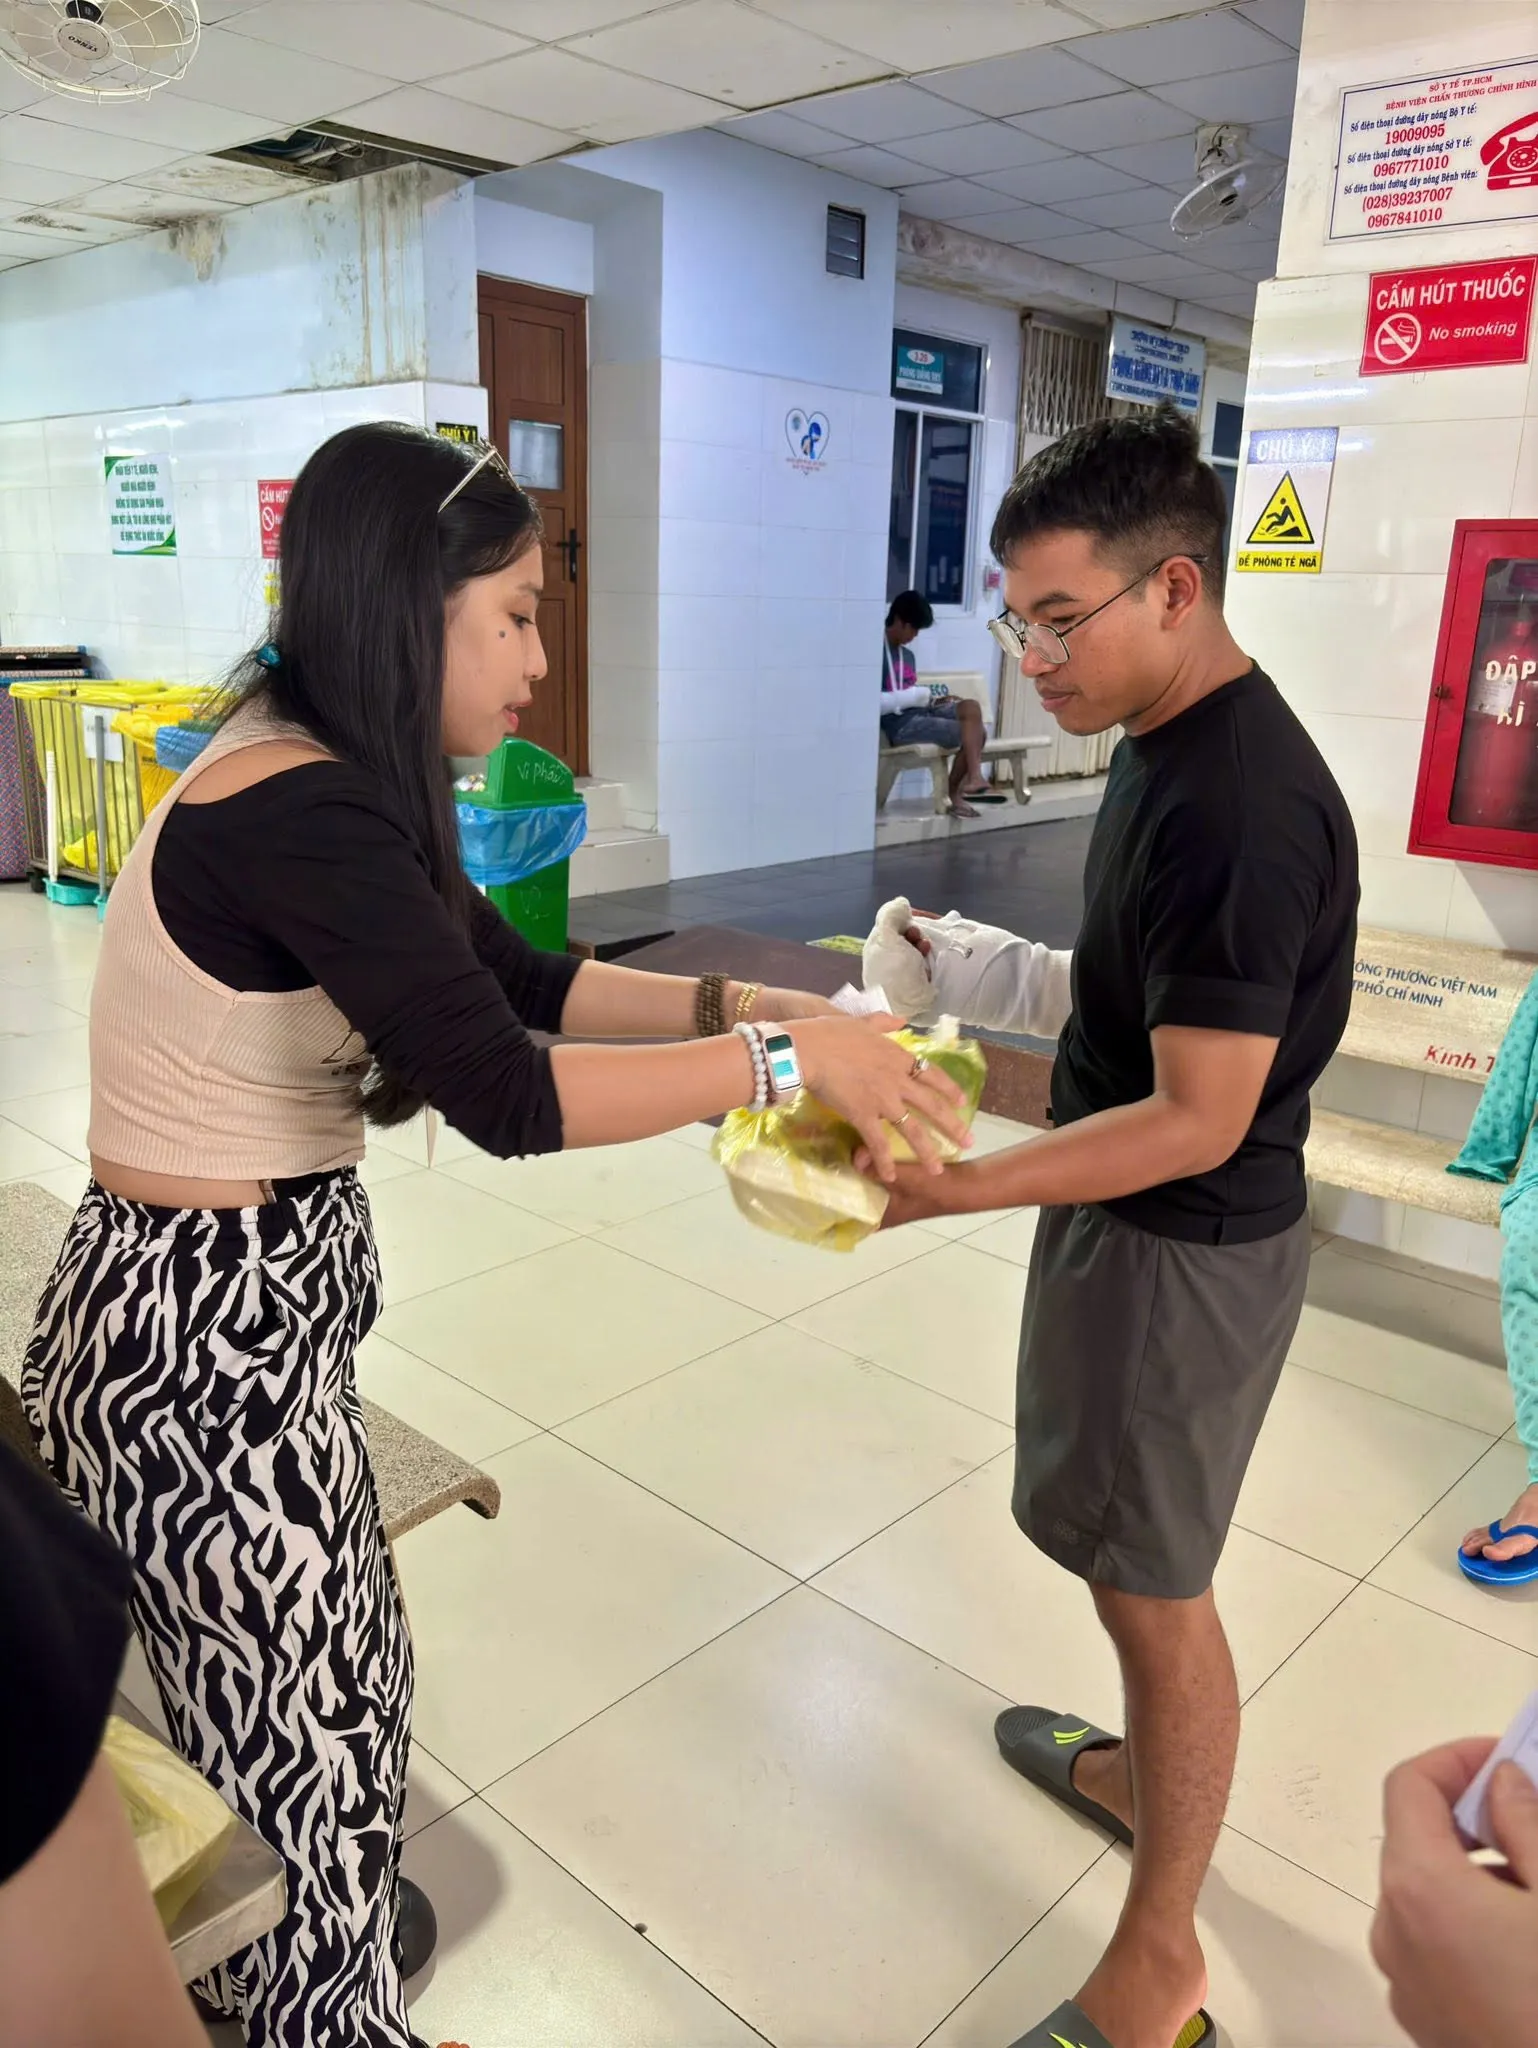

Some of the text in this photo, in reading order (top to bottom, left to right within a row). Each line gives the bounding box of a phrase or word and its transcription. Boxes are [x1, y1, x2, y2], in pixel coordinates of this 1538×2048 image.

[1450, 78, 1461, 88] TẾ
[1462, 76, 1492, 86] TP.HCM
[1350, 120, 1360, 132] Số
[1430, 109, 1447, 121] nóng
[1449, 108, 1458, 117] Bộ
[1460, 106, 1466, 115] Y
[1385, 124, 1446, 145] 19009095
[1347, 153, 1356, 164] Số
[1426, 141, 1444, 152] nóng
[1456, 139, 1462, 148] Y
[1374, 154, 1449, 178] 0967771010
[1344, 182, 1354, 194] Số
[1422, 174, 1440, 185] nóng
[1441, 171, 1458, 182] Bệnh
[1362, 187, 1453, 212] (028)39237007
[1368, 208, 1442, 228] 0967841010
[1376, 268, 1526, 310] CẤM HÚT THUỐC
[1429, 320, 1518, 340] No smoking
[260, 484, 274, 504] CẤM
[1253, 555, 1282, 568] PHÒNG
[1299, 556, 1316, 568] NGÃ
[1354, 958, 1498, 998] ÔNG THƯƠNG VIỆT NAM
[1386, 986, 1410, 1001] CHÍ
[1410, 990, 1444, 1008] MINH
[1486, 1056, 1496, 1073] T
